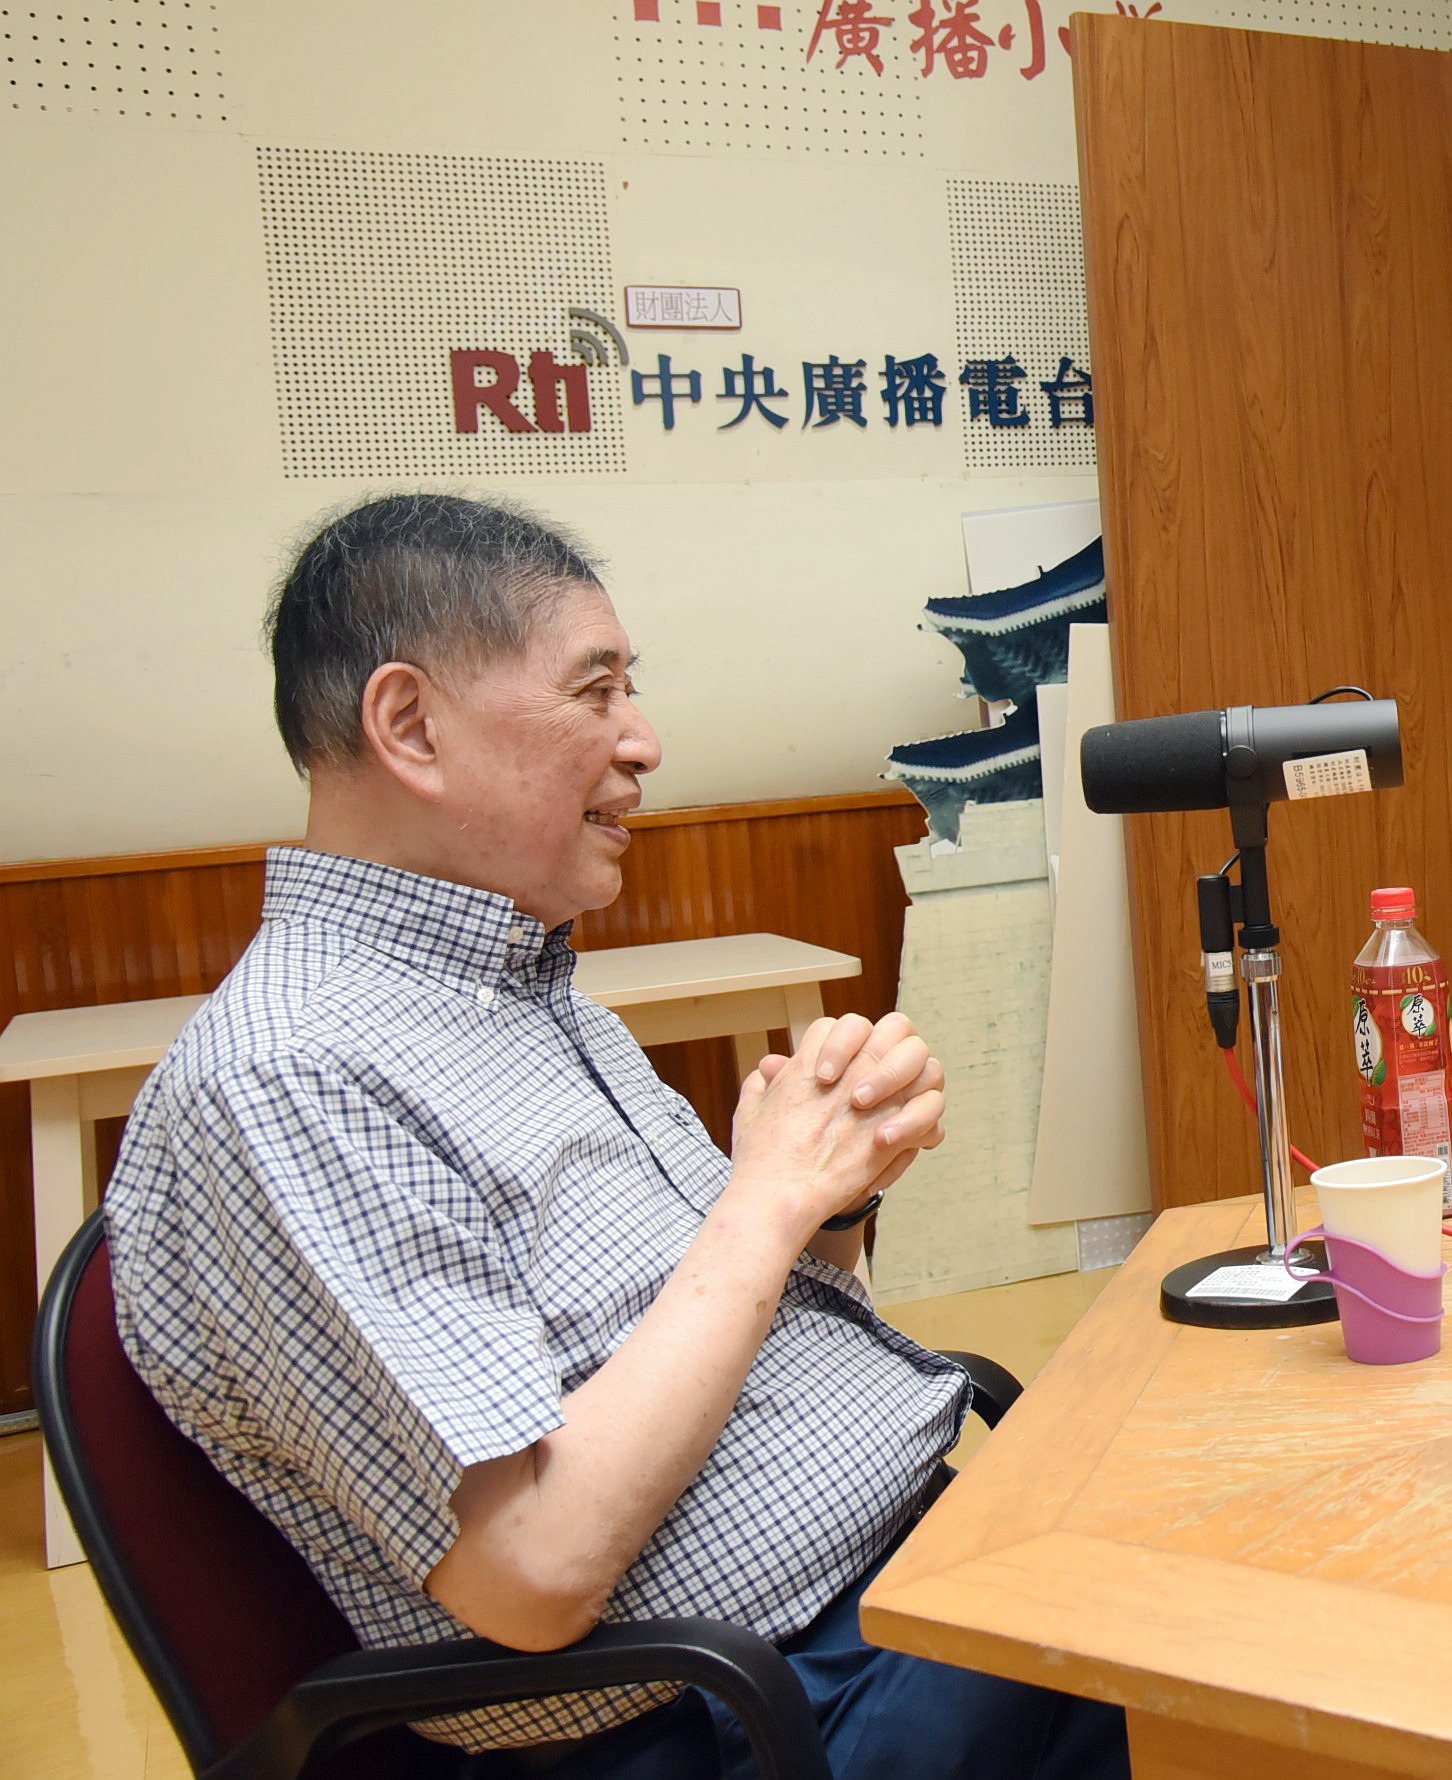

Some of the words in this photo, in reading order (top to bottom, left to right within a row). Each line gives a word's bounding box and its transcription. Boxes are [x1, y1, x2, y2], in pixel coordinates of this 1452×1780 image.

[805, 0, 1160, 81] 廣播小
[635, 291, 733, 322] 財團法人
[630, 352, 1096, 431] 中央廣播電台
[1407, 994, 1427, 1037] 原萃
